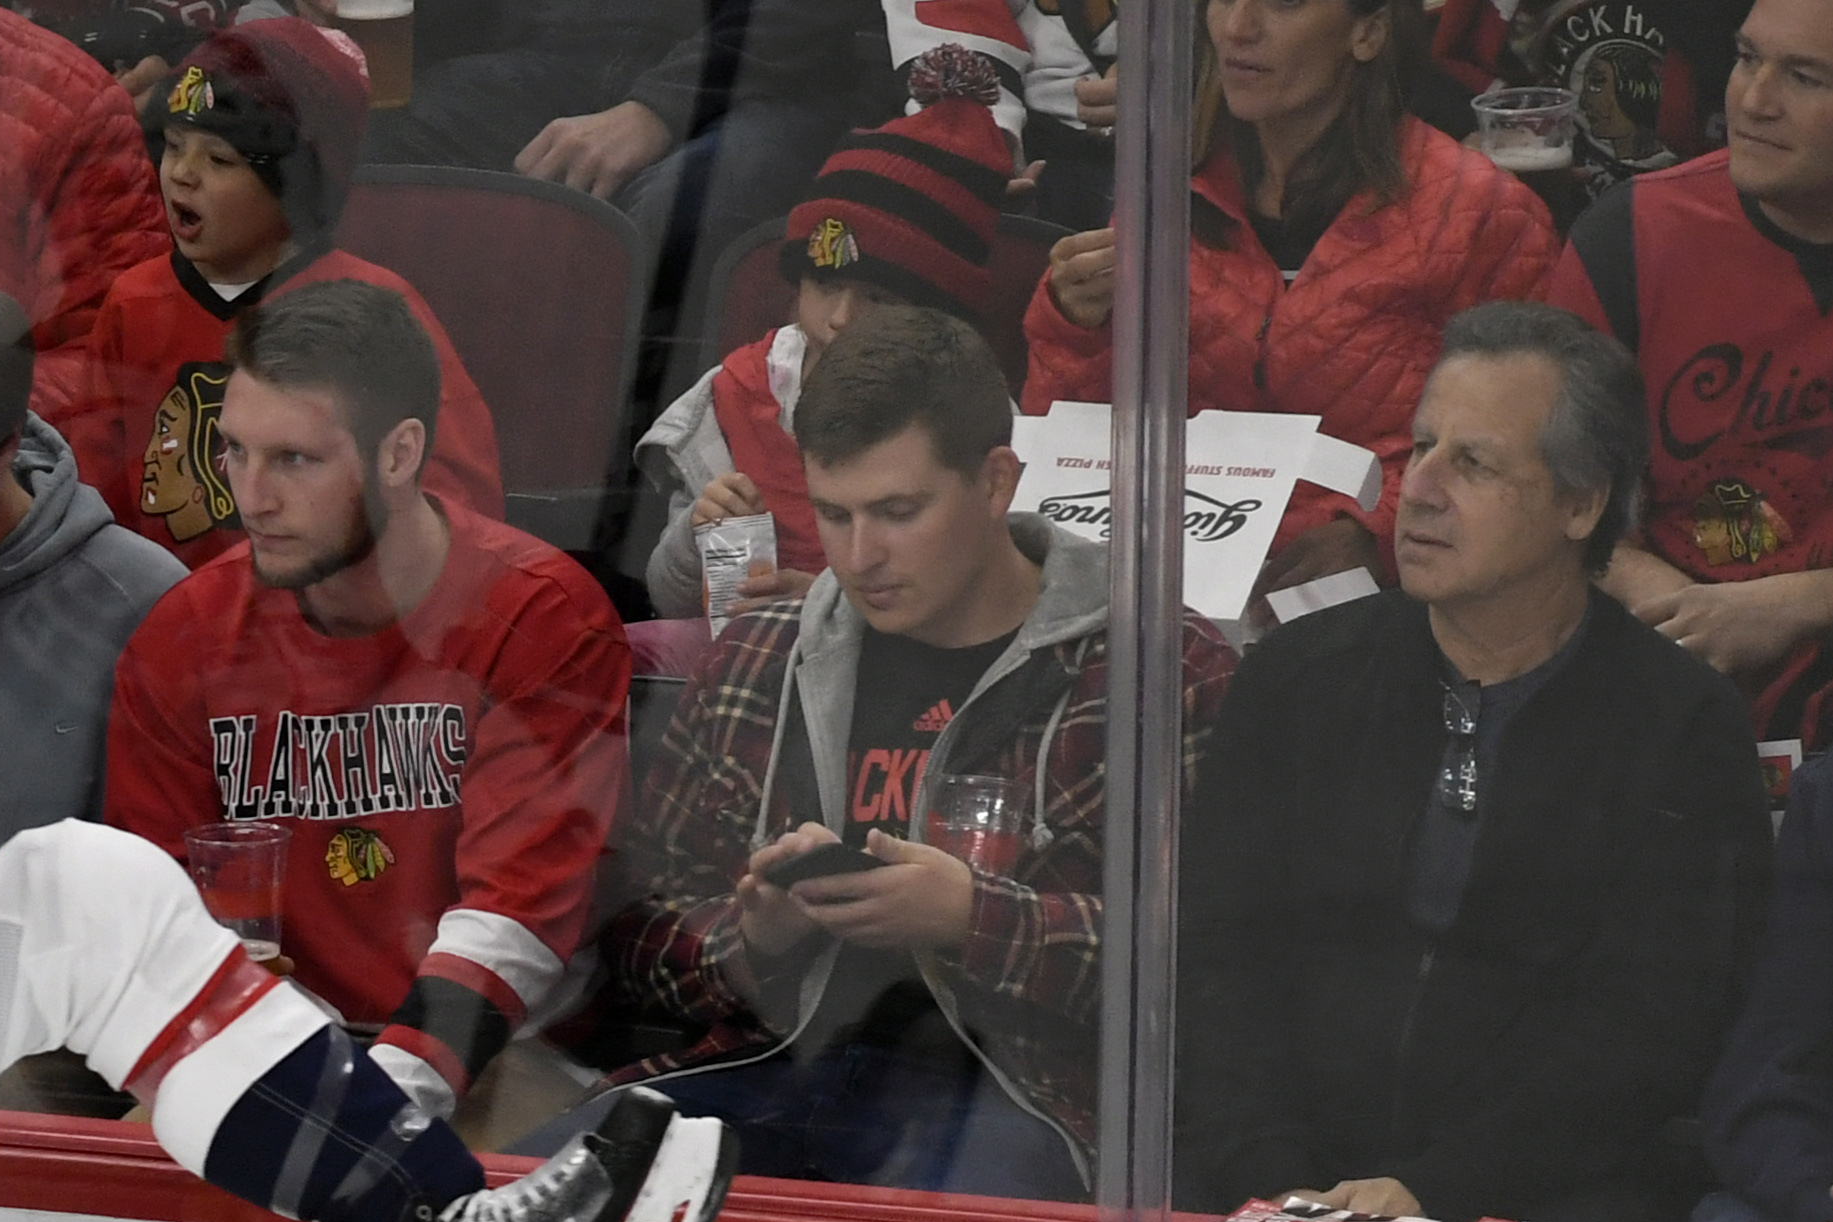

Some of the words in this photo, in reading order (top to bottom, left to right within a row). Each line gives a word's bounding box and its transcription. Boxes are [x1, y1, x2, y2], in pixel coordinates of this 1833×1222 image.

[1659, 342, 1833, 461] Chic
[1056, 457, 1092, 469] PIZZA
[1186, 464, 1224, 476] STUFF
[1226, 465, 1277, 478] FAMOUS
[209, 702, 466, 821] BLACKHAWKS
[849, 748, 931, 823] CK
